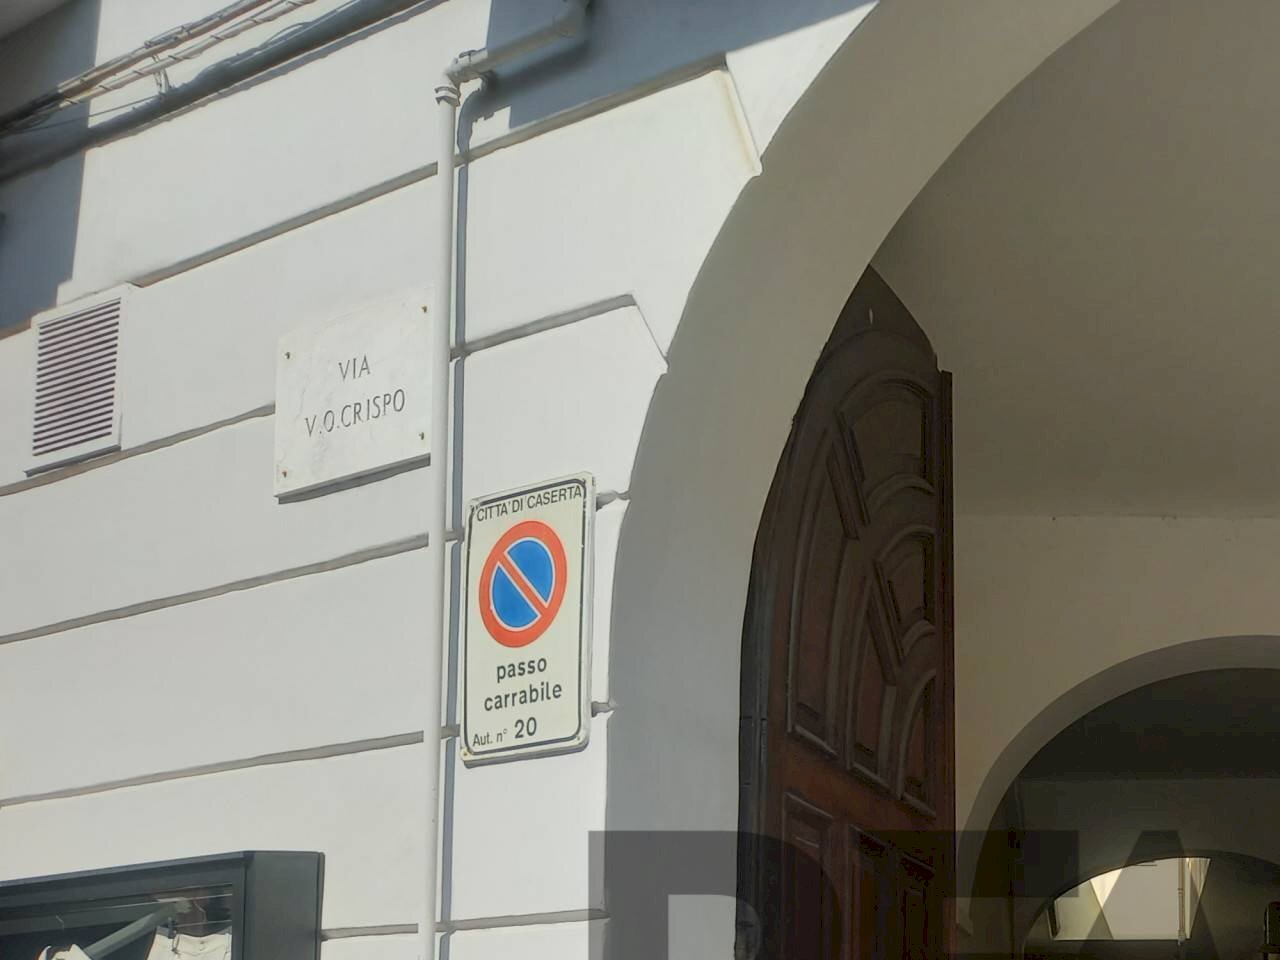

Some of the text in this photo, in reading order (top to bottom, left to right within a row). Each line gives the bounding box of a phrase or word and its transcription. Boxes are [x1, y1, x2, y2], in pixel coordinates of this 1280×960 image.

[338, 354, 371, 381] VIA
[476, 485, 582, 522] CITTA' DI CASERTA
[496, 658, 547, 684] passo
[484, 681, 562, 711] carrabile
[472, 731, 493, 747] Aut.
[514, 716, 537, 739] 20
